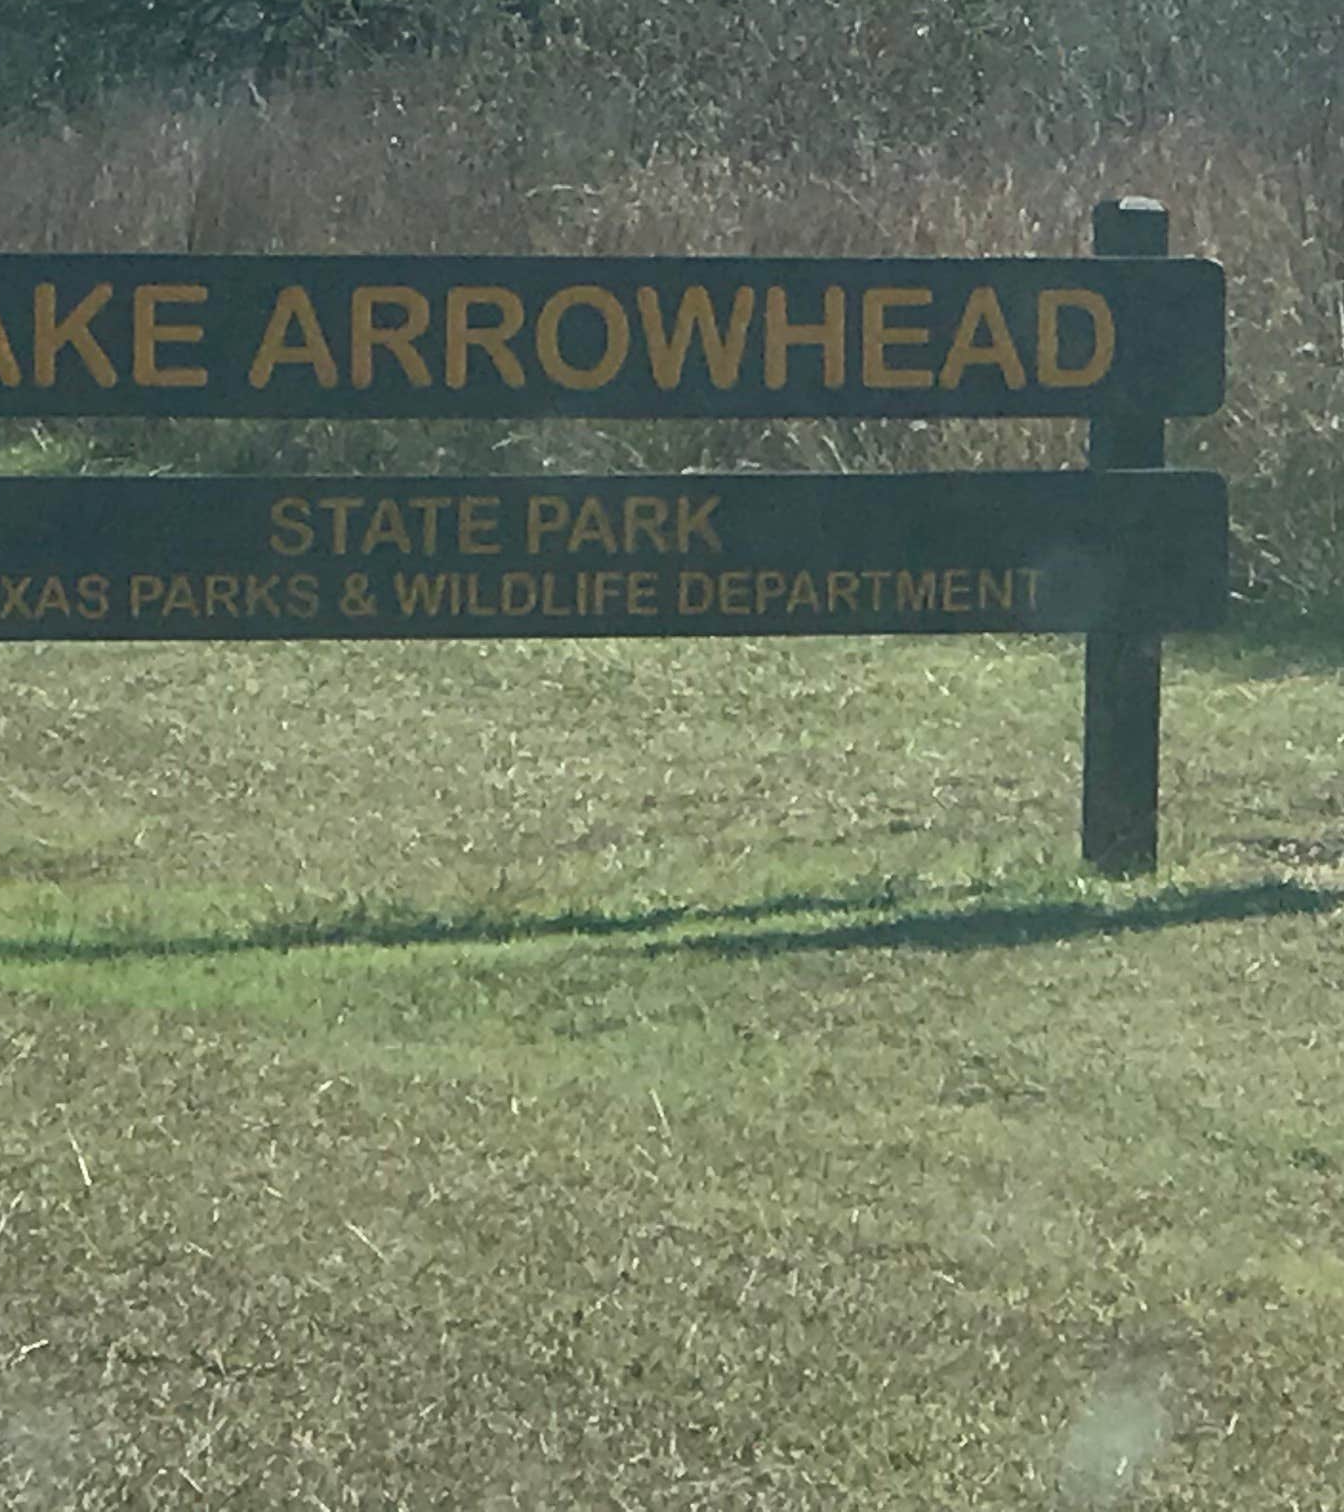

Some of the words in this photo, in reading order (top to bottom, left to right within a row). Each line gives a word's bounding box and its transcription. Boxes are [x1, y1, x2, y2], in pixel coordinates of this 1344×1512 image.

[248, 284, 1117, 390] ARROWHEAD
[268, 496, 504, 556] STATE
[525, 494, 724, 555] PARK
[130, 573, 320, 620] PARKS
[338, 572, 381, 618] &
[393, 570, 660, 618] WILDLIFE
[677, 567, 1047, 618] DEPARTMENT
